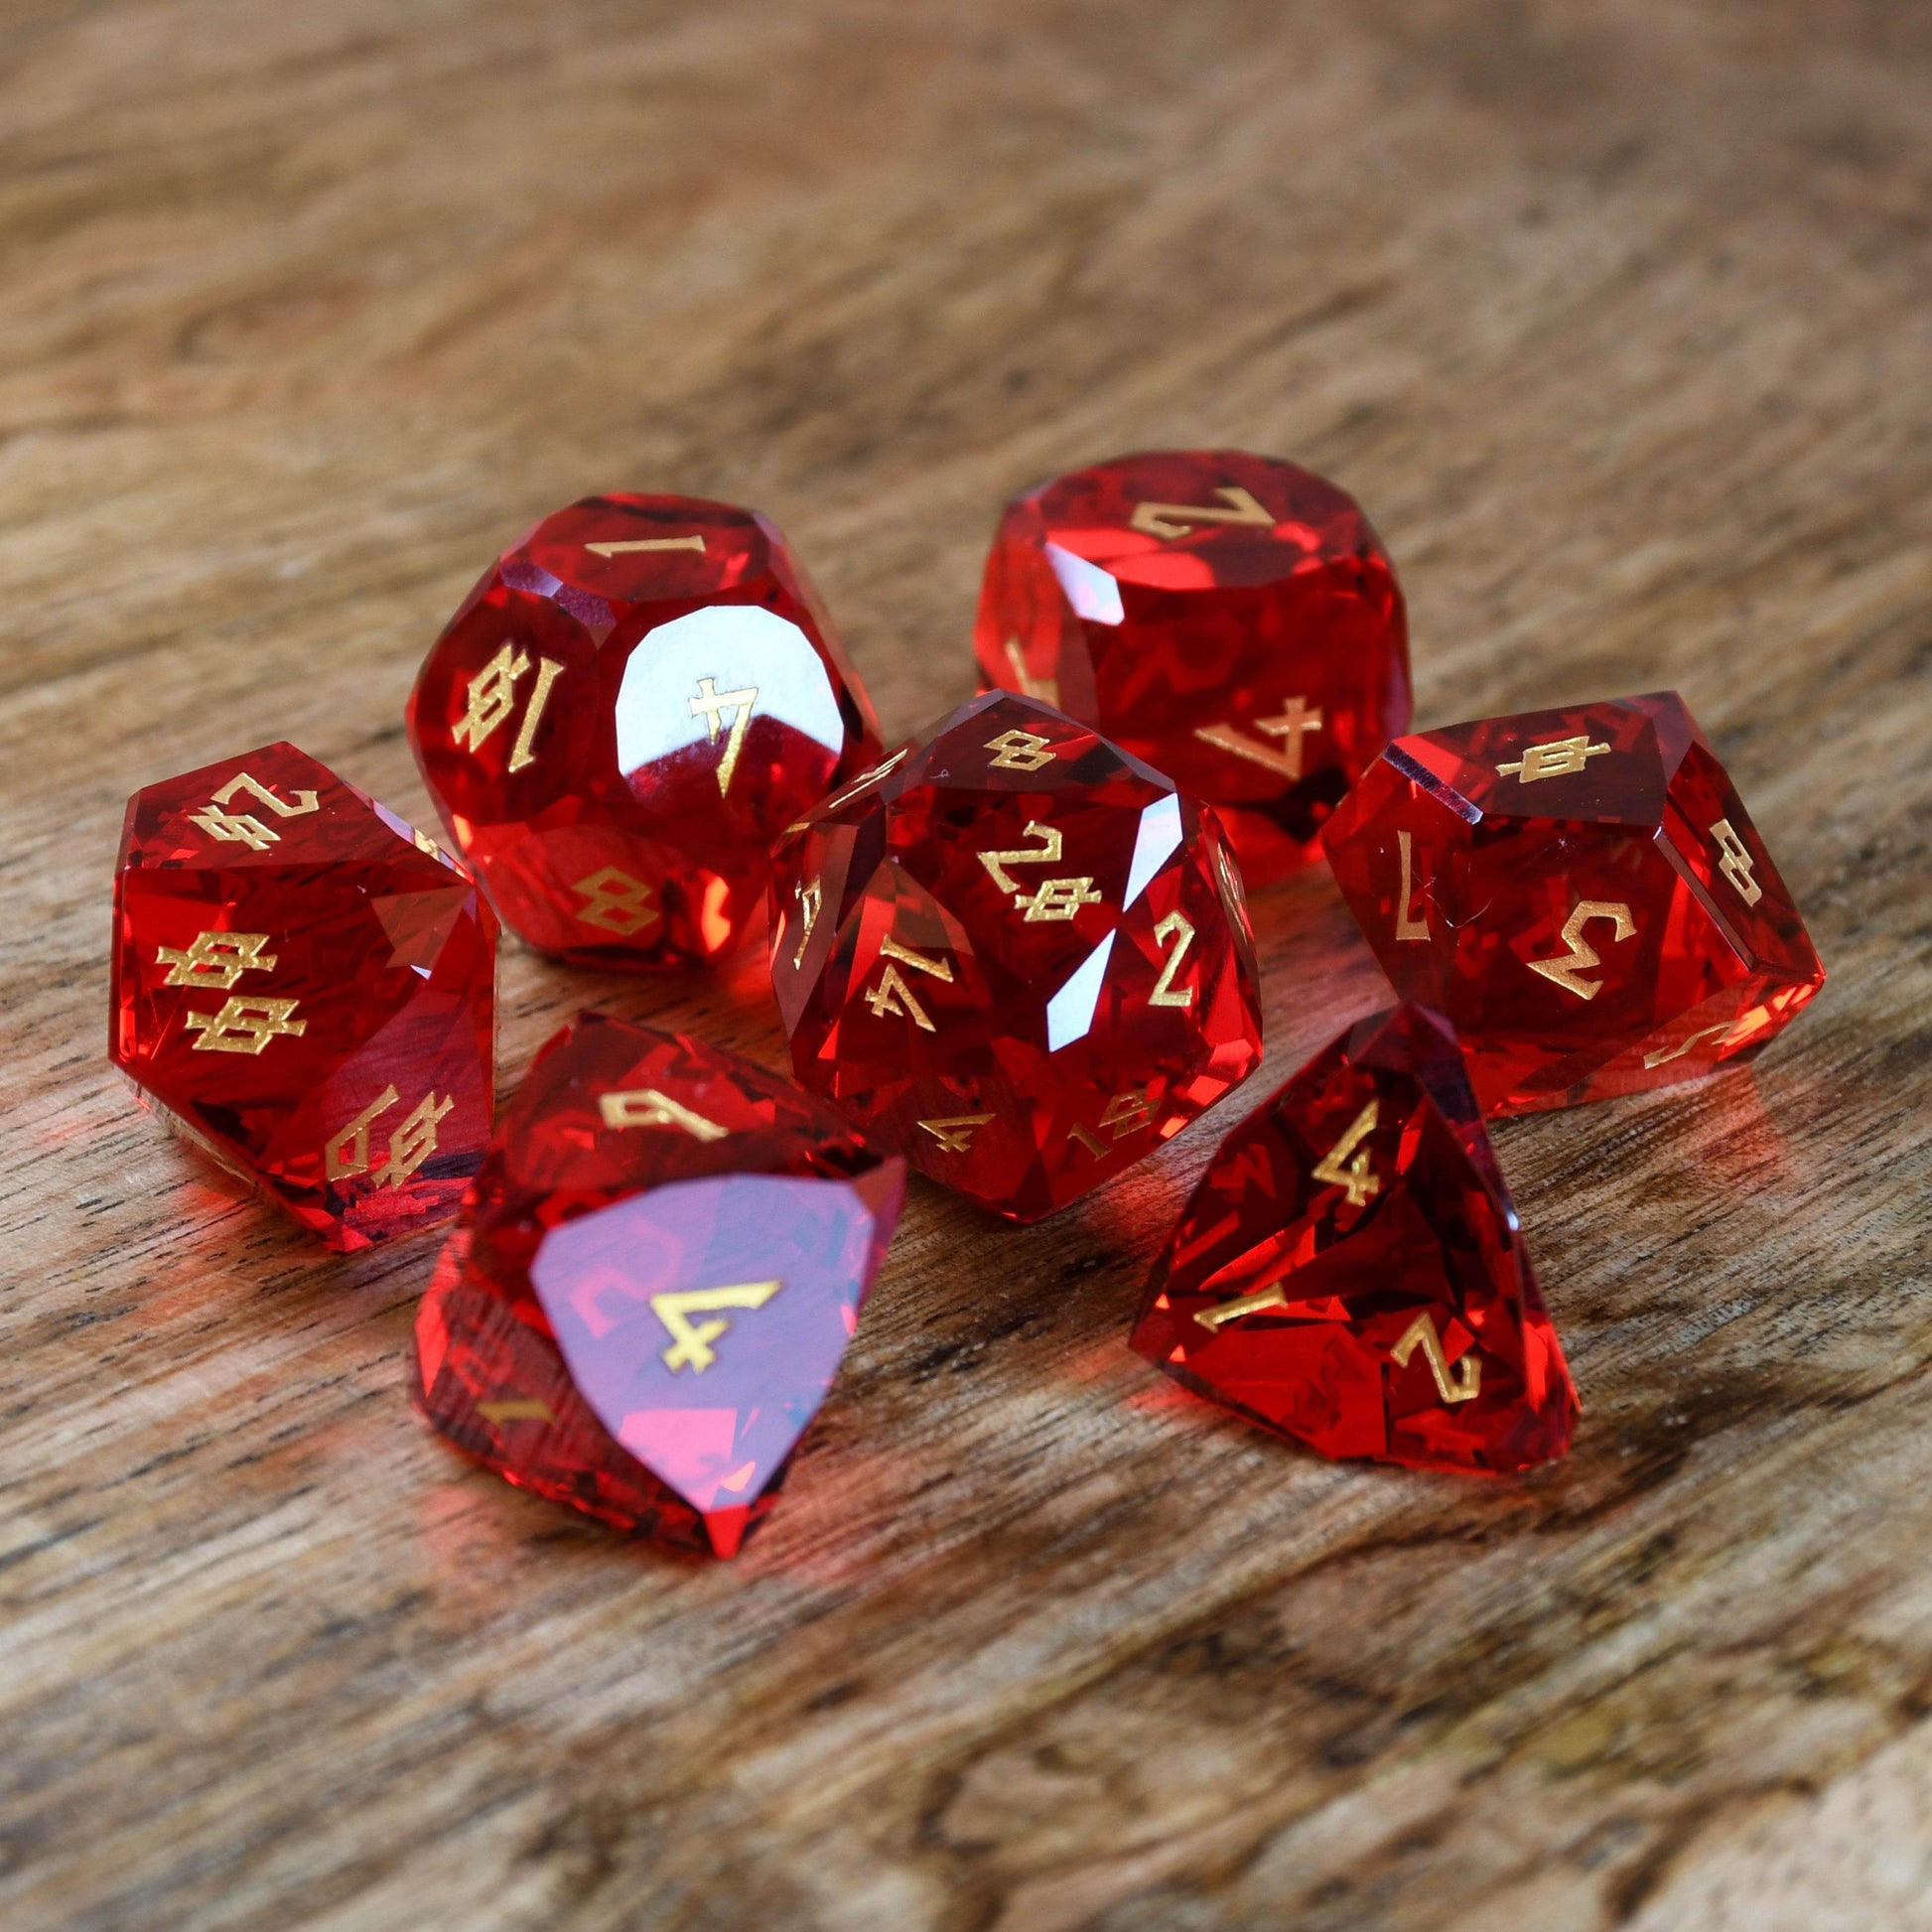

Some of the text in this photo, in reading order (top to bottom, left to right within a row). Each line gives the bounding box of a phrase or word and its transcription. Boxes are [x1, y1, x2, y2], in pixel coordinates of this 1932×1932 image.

[1131, 486, 1275, 539] 2
[689, 677, 759, 798] 4
[1194, 697, 1322, 780] 4
[1148, 909, 1194, 1007] 2
[1526, 899, 1638, 1001] 3
[916, 1114, 996, 1153] 4
[1311, 1097, 1380, 1206] 4
[649, 1279, 783, 1375] 4
[1193, 1280, 1288, 1333] 1
[1392, 1311, 1481, 1403] 2
